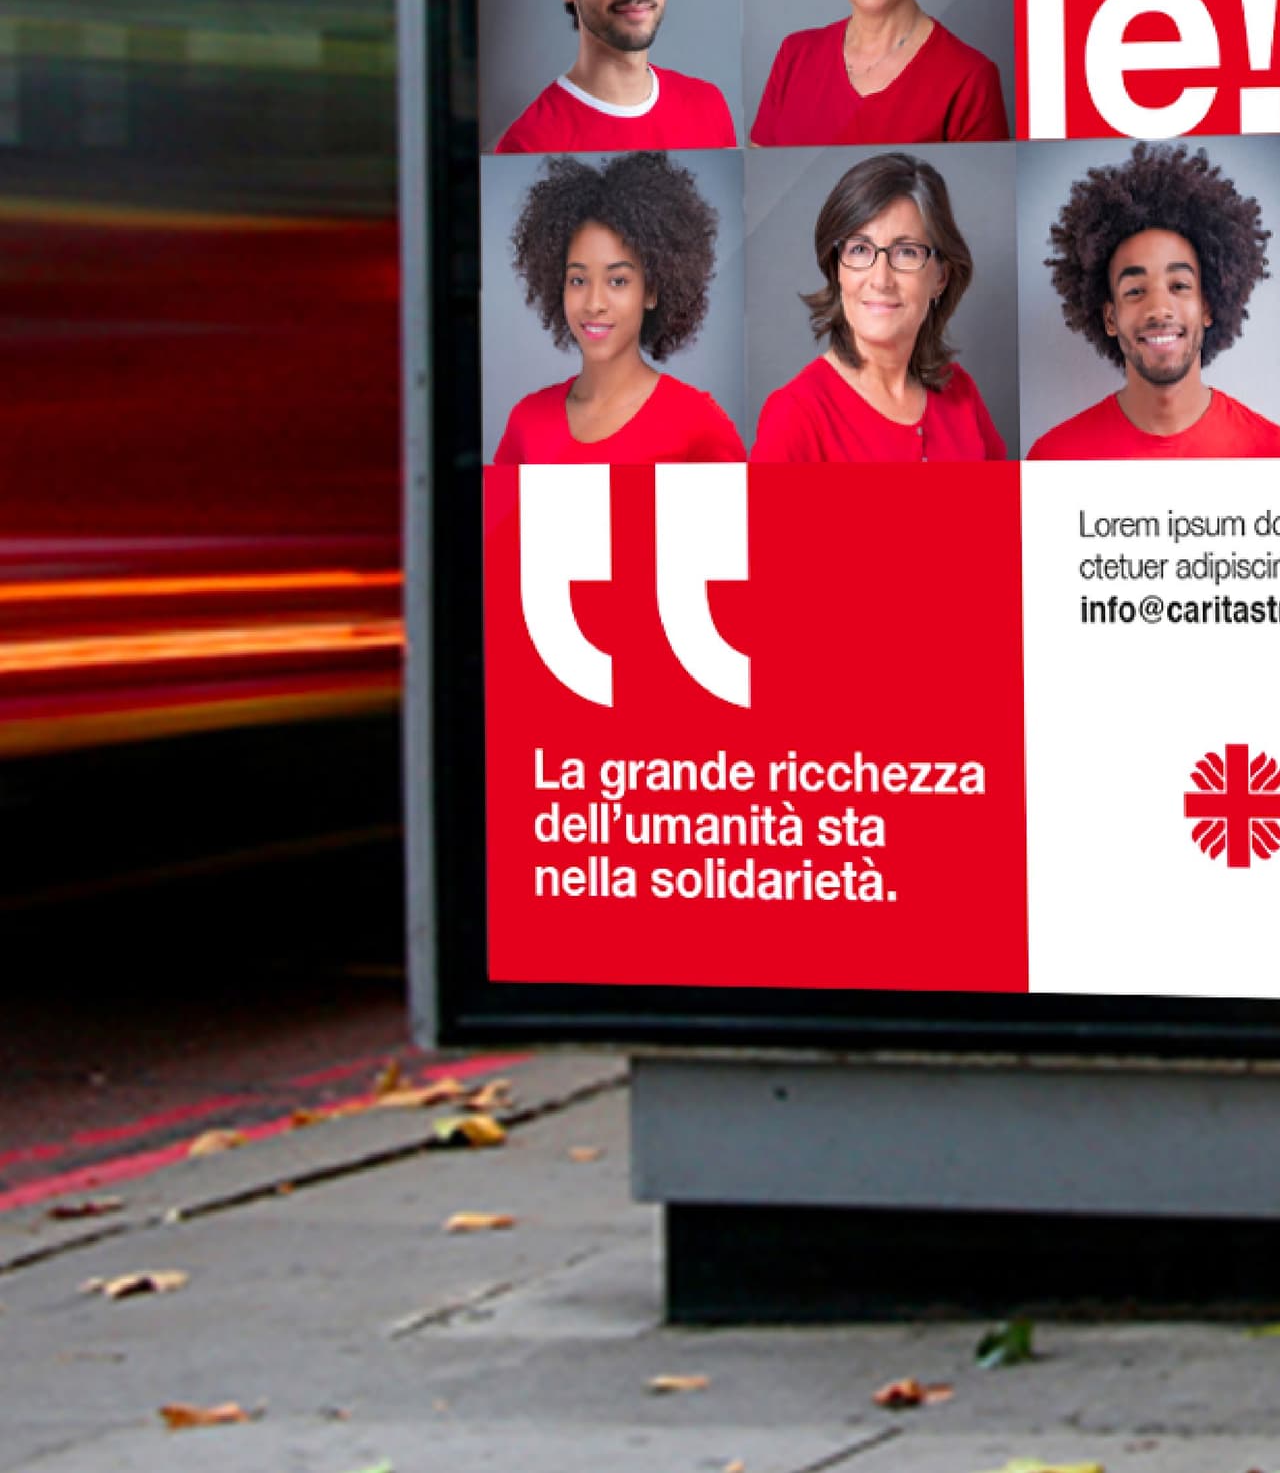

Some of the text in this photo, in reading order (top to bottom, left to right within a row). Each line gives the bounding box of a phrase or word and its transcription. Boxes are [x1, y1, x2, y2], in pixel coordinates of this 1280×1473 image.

[1079, 510, 1160, 538] Lorem
[1168, 510, 1246, 544] ipsum
[1079, 553, 1168, 579] ctetuer
[534, 747, 986, 800] La grande ricchezza
[817, 807, 886, 847] sta
[534, 856, 897, 902] nella solidarietà.
